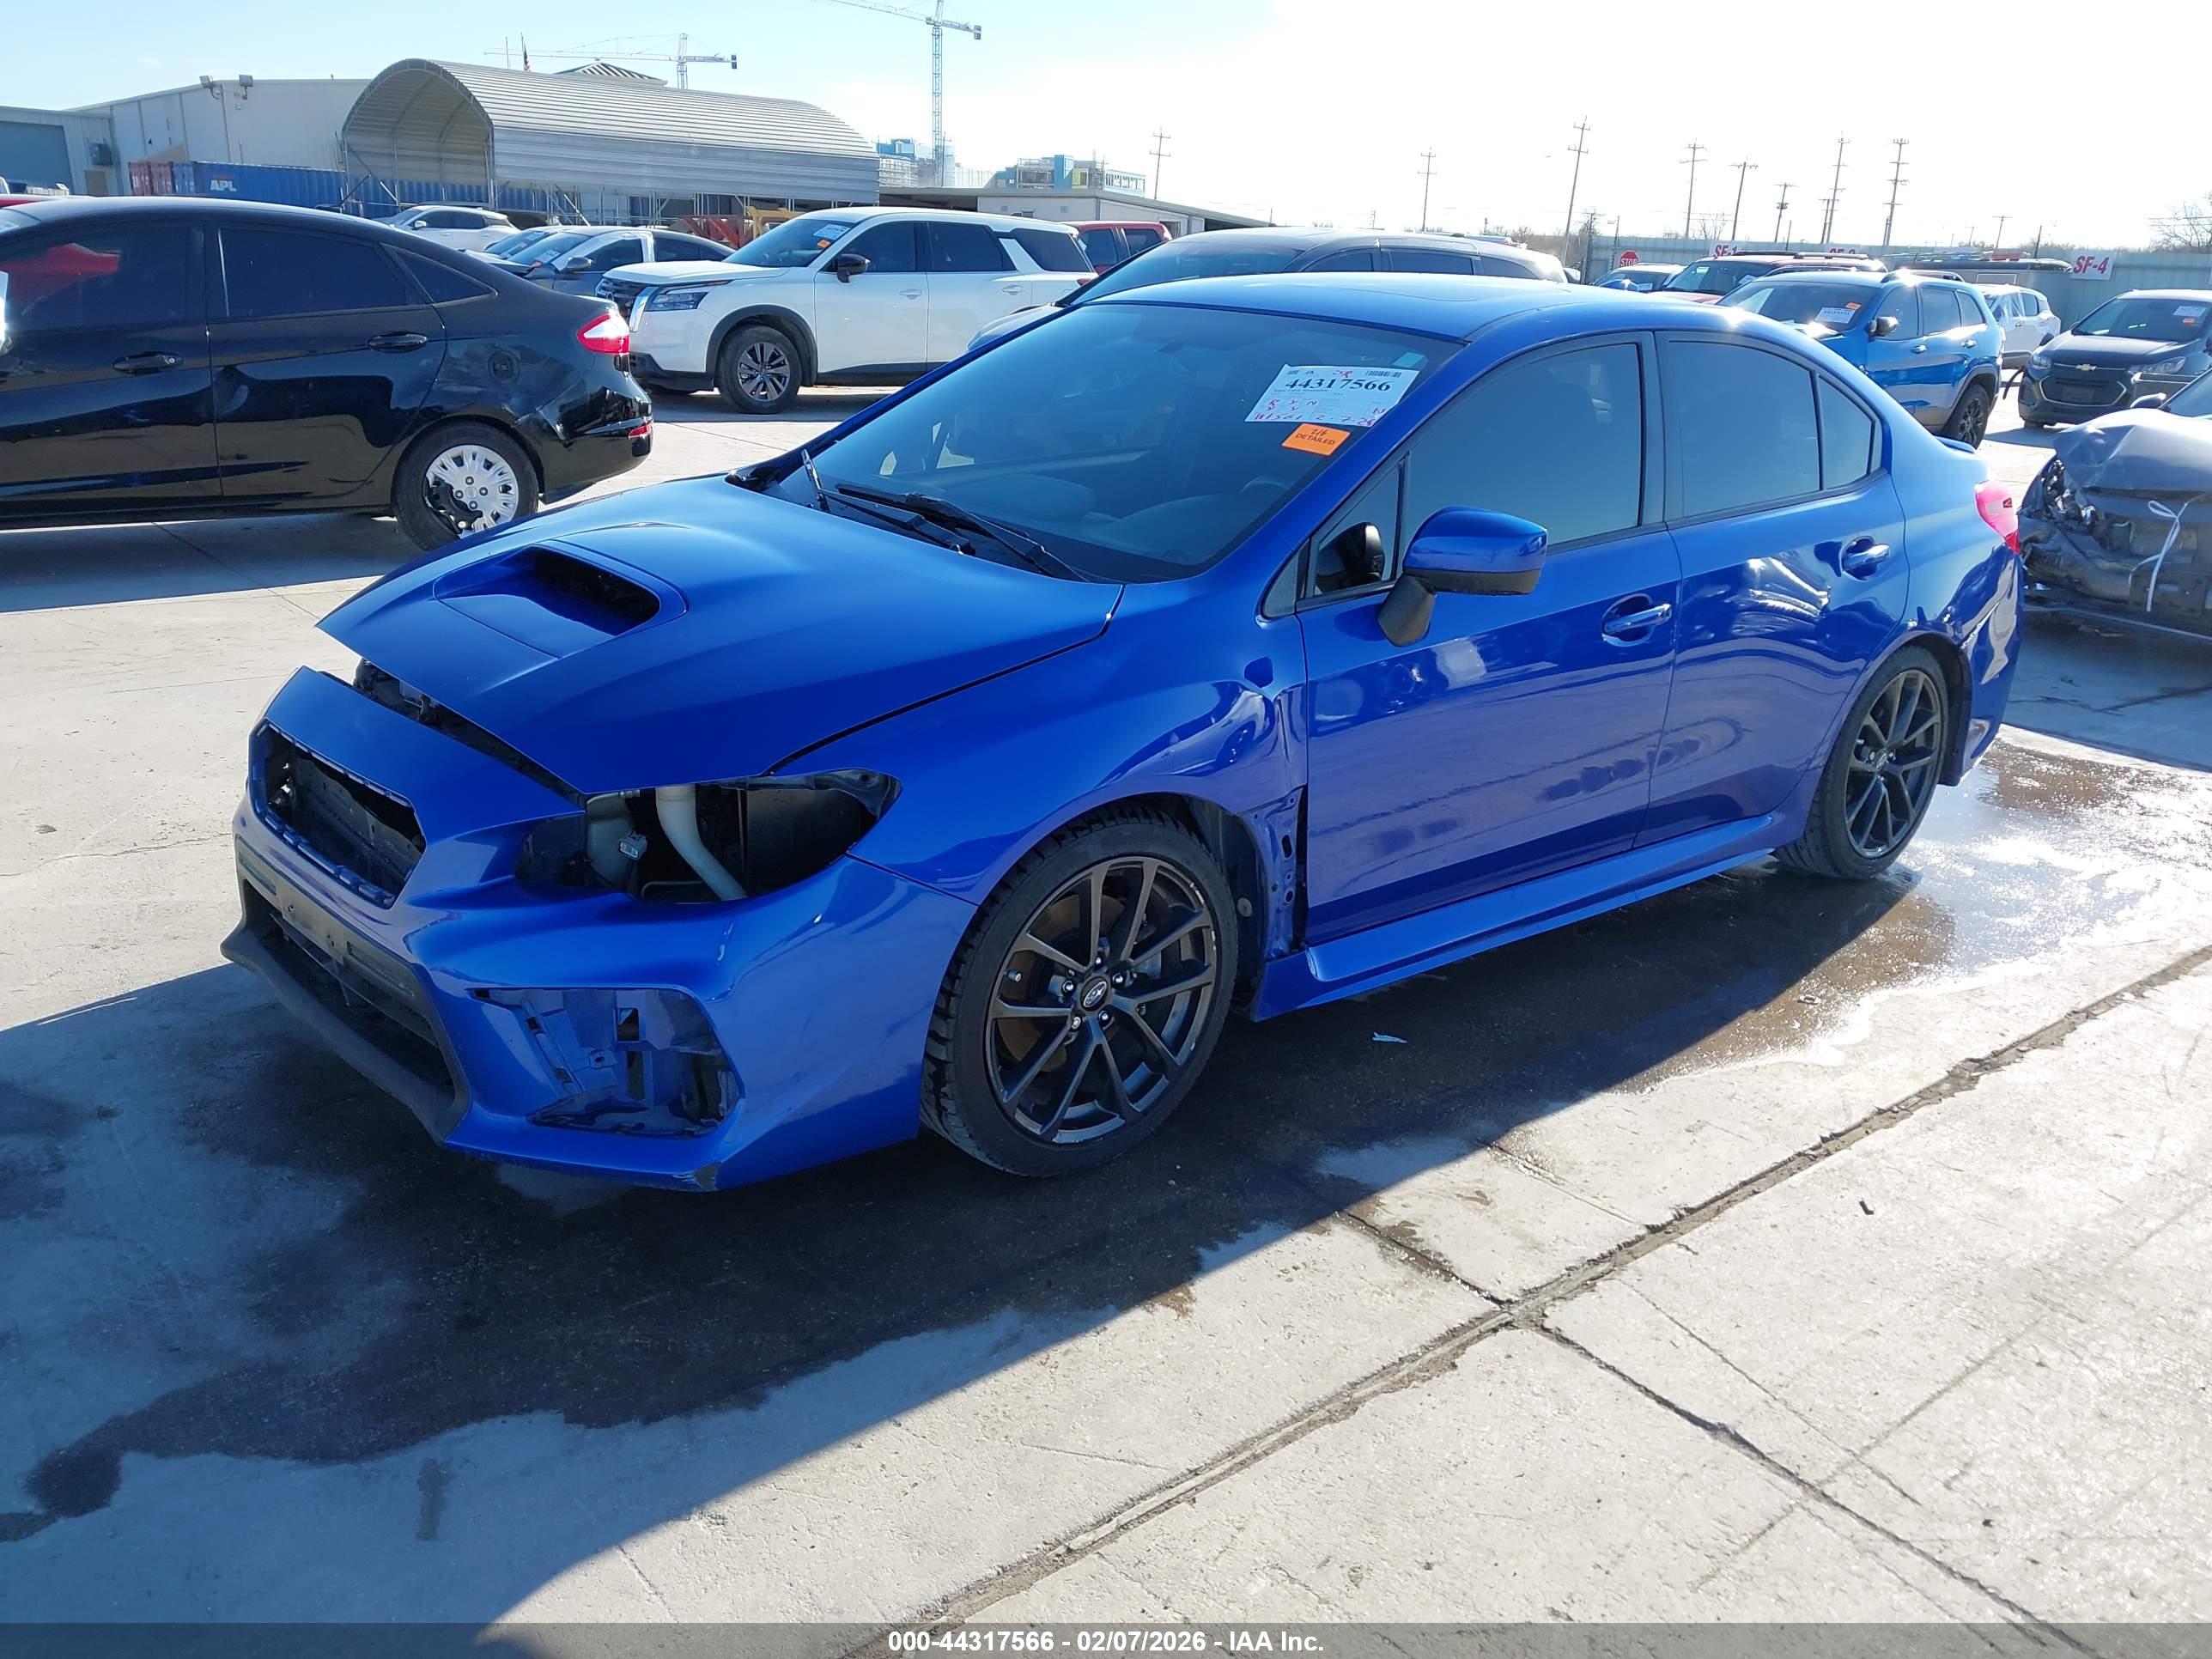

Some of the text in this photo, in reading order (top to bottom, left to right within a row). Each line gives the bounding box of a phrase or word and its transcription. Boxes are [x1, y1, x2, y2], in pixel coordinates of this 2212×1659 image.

[210, 179, 237, 192] APL
[1620, 258, 1638, 267] STOP
[2073, 255, 2110, 274] SF-4
[1285, 378, 1395, 392] 44317566
[1295, 433, 1336, 445] DETAILED
